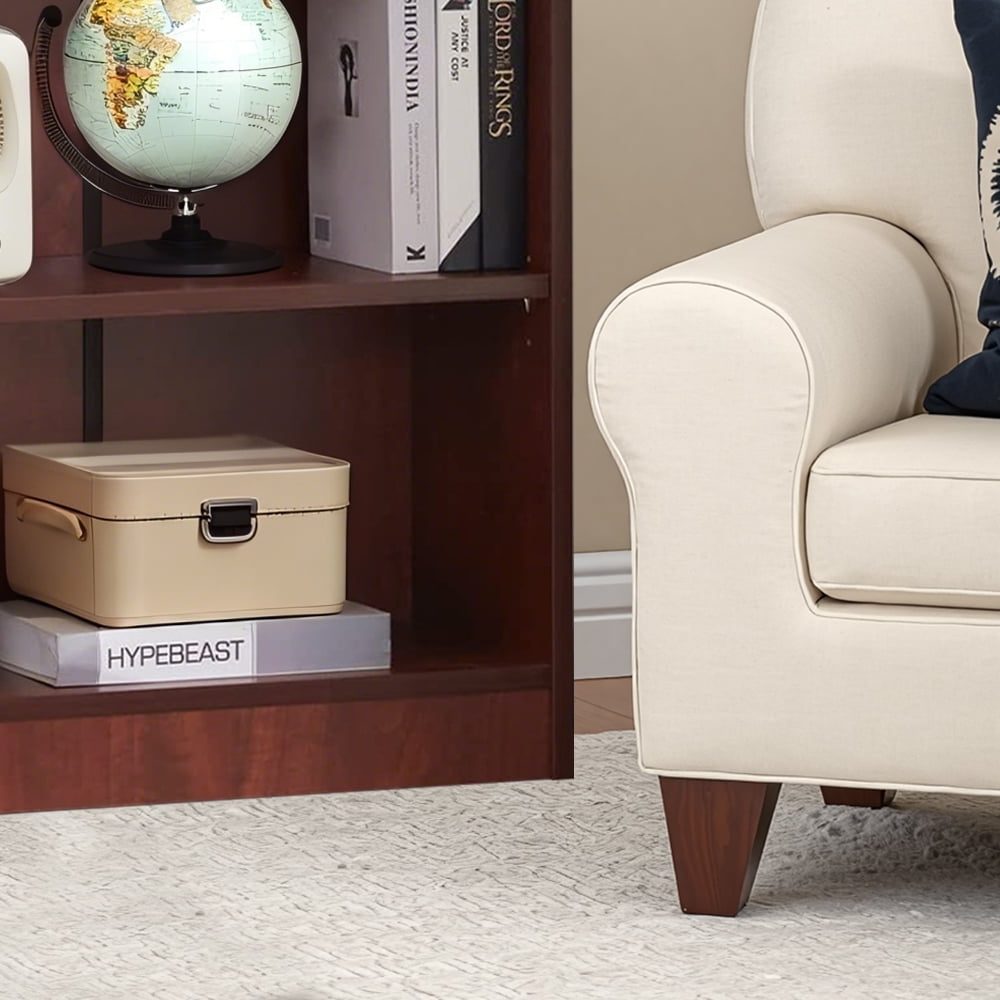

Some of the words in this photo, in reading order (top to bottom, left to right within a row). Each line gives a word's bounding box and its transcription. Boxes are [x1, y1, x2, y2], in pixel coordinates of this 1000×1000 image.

[451, 32, 459, 52] ANY
[461, 15, 470, 53] JUSTICE
[451, 57, 459, 82] COST
[461, 57, 470, 68] AT
[488, 67, 514, 138] RINGS
[406, 245, 426, 261] K
[107, 639, 245, 669] HYPEBEAST
